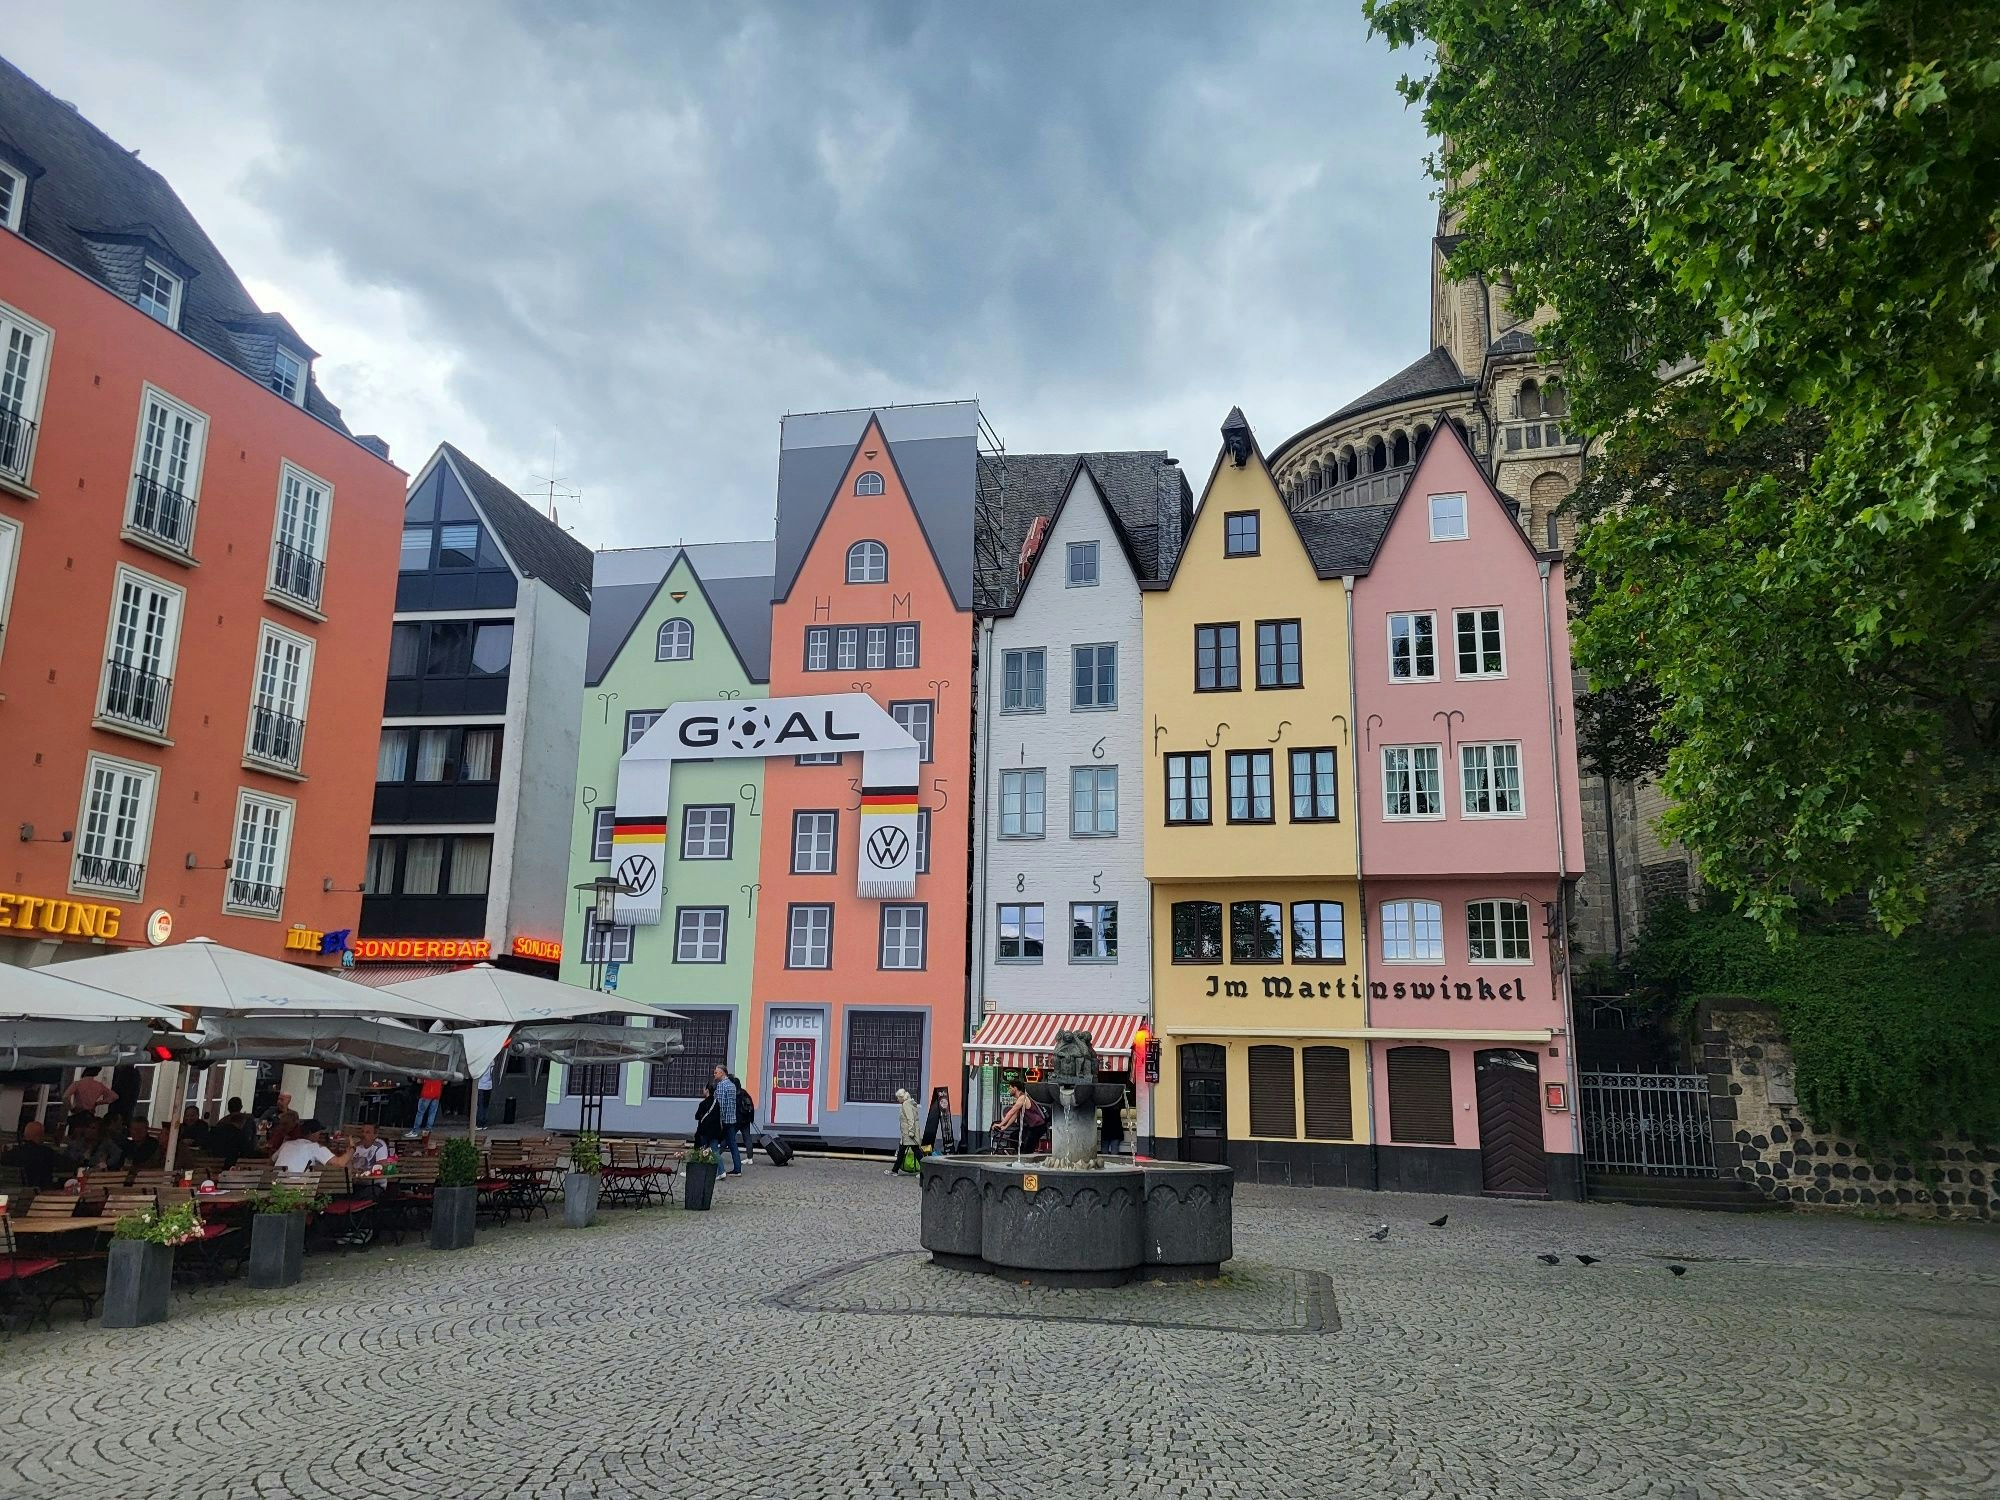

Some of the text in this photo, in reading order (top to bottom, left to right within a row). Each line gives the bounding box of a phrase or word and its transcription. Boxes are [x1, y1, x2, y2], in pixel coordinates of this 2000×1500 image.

[354, 939, 490, 958] SONDERBAR
[1206, 974, 1527, 1001] Im Martinswinkel
[774, 1015, 819, 1029] HOTEL
[981, 1053, 1002, 1065] Eis
